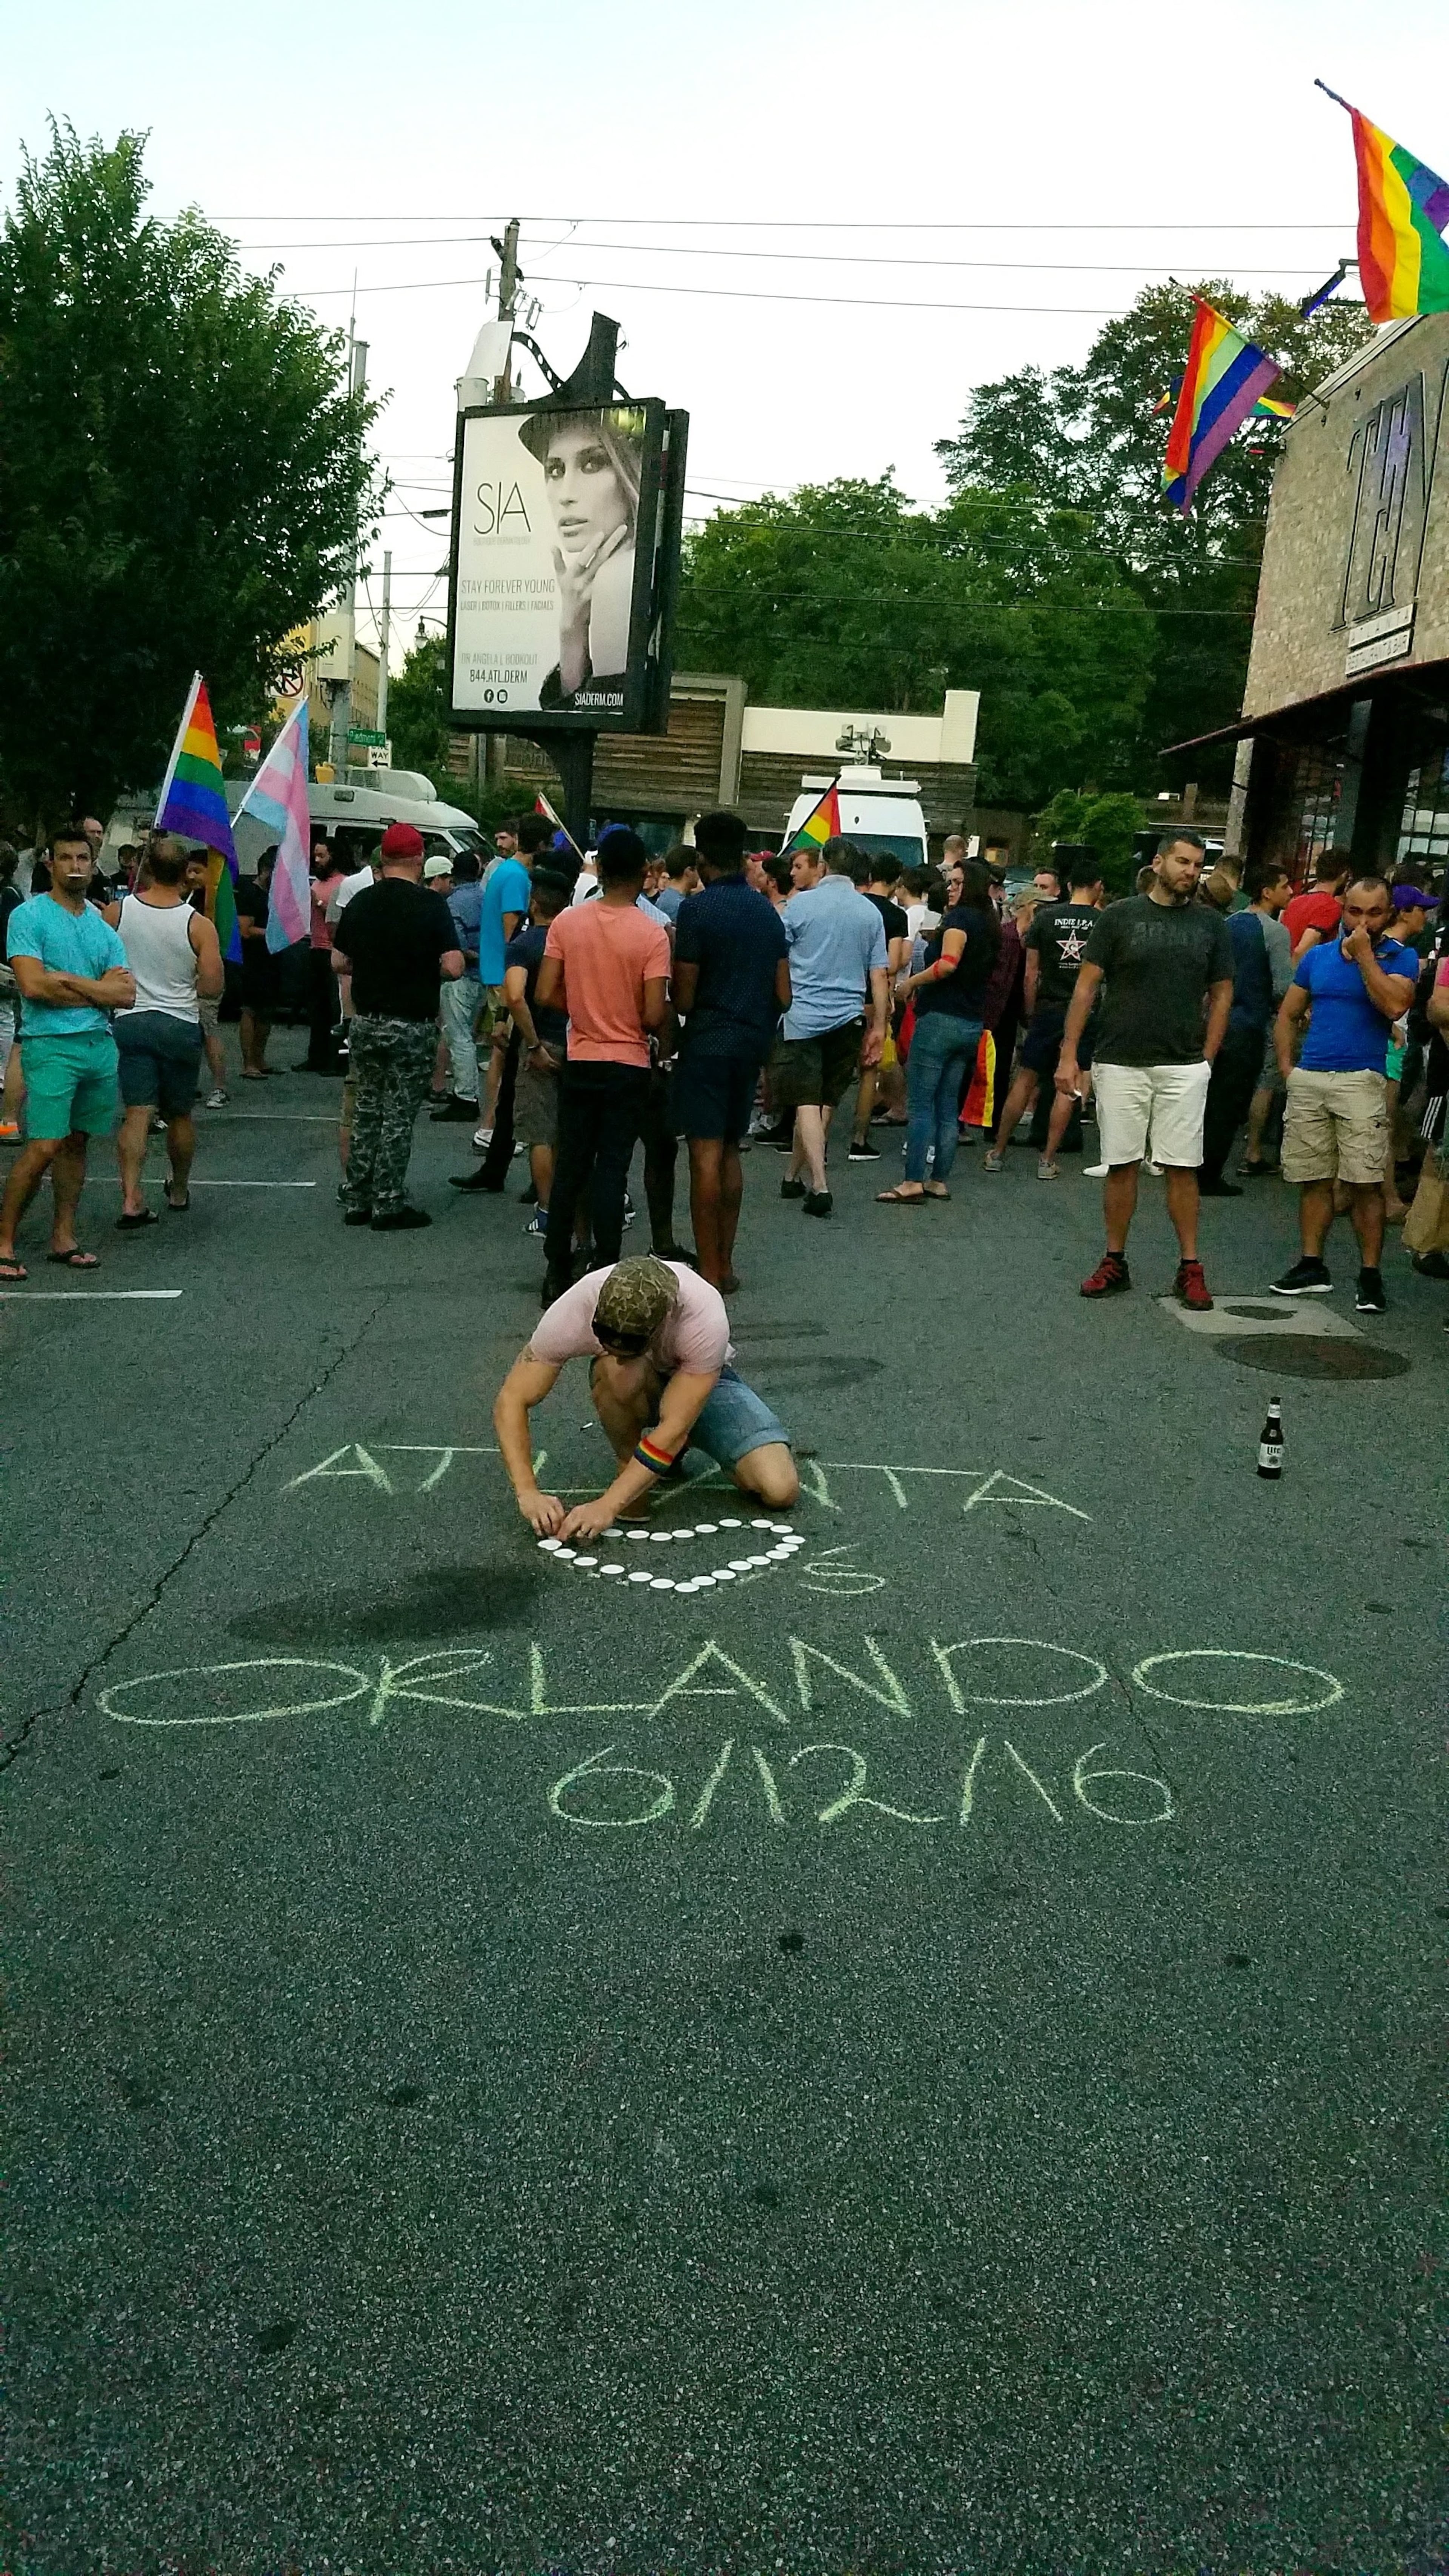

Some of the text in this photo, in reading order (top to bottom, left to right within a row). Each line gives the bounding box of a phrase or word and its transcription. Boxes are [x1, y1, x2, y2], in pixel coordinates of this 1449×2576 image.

[474, 481, 531, 534] SIA
[461, 579, 555, 594] STAY FOREVER YOUNG
[482, 601, 500, 611] BOTOX
[505, 601, 526, 611] FILLERS
[531, 600, 554, 611] FACIALS
[472, 653, 498, 665] ANGELA
[575, 692, 623, 706] SIADERM.COM
[94, 1633, 1345, 1726] ORLANDO
[546, 1738, 1175, 1829] 6/12/16
